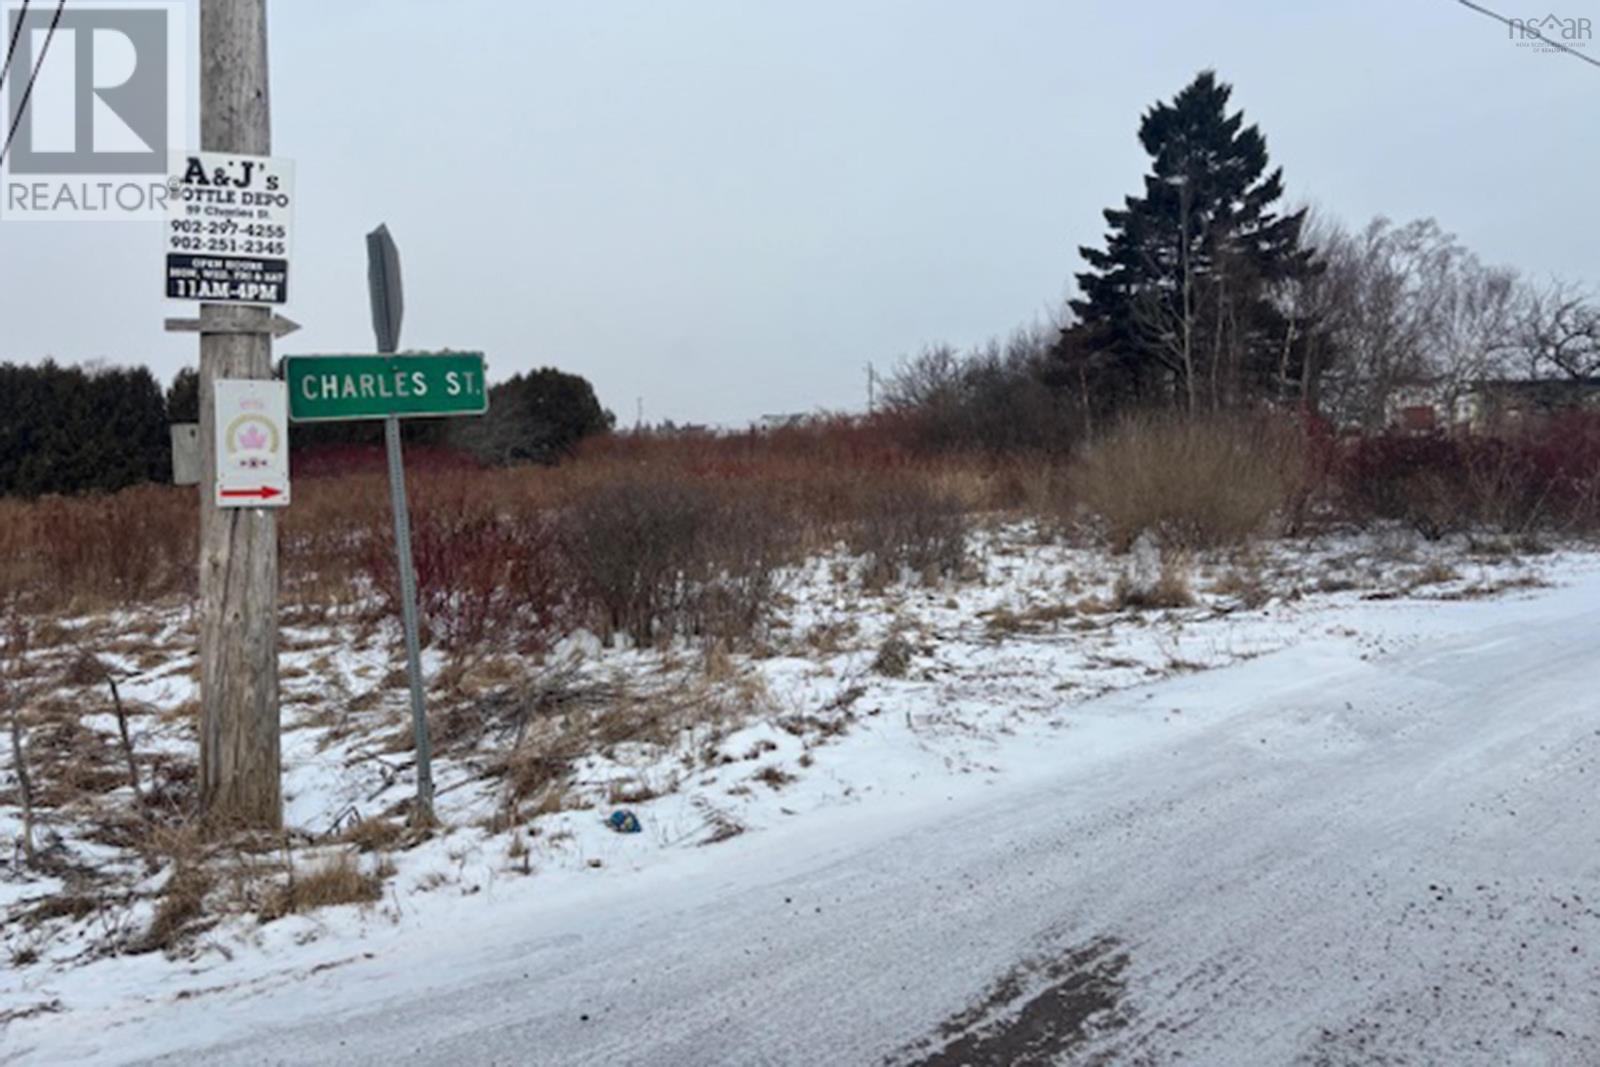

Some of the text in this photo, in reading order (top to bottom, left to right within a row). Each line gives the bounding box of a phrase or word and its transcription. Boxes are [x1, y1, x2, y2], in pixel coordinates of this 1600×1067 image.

[241, 191, 289, 208] DEPO
[170, 236, 285, 255] 902-251-2345
[192, 258, 223, 269] OPEN
[302, 371, 481, 400] CHARLES ST.
